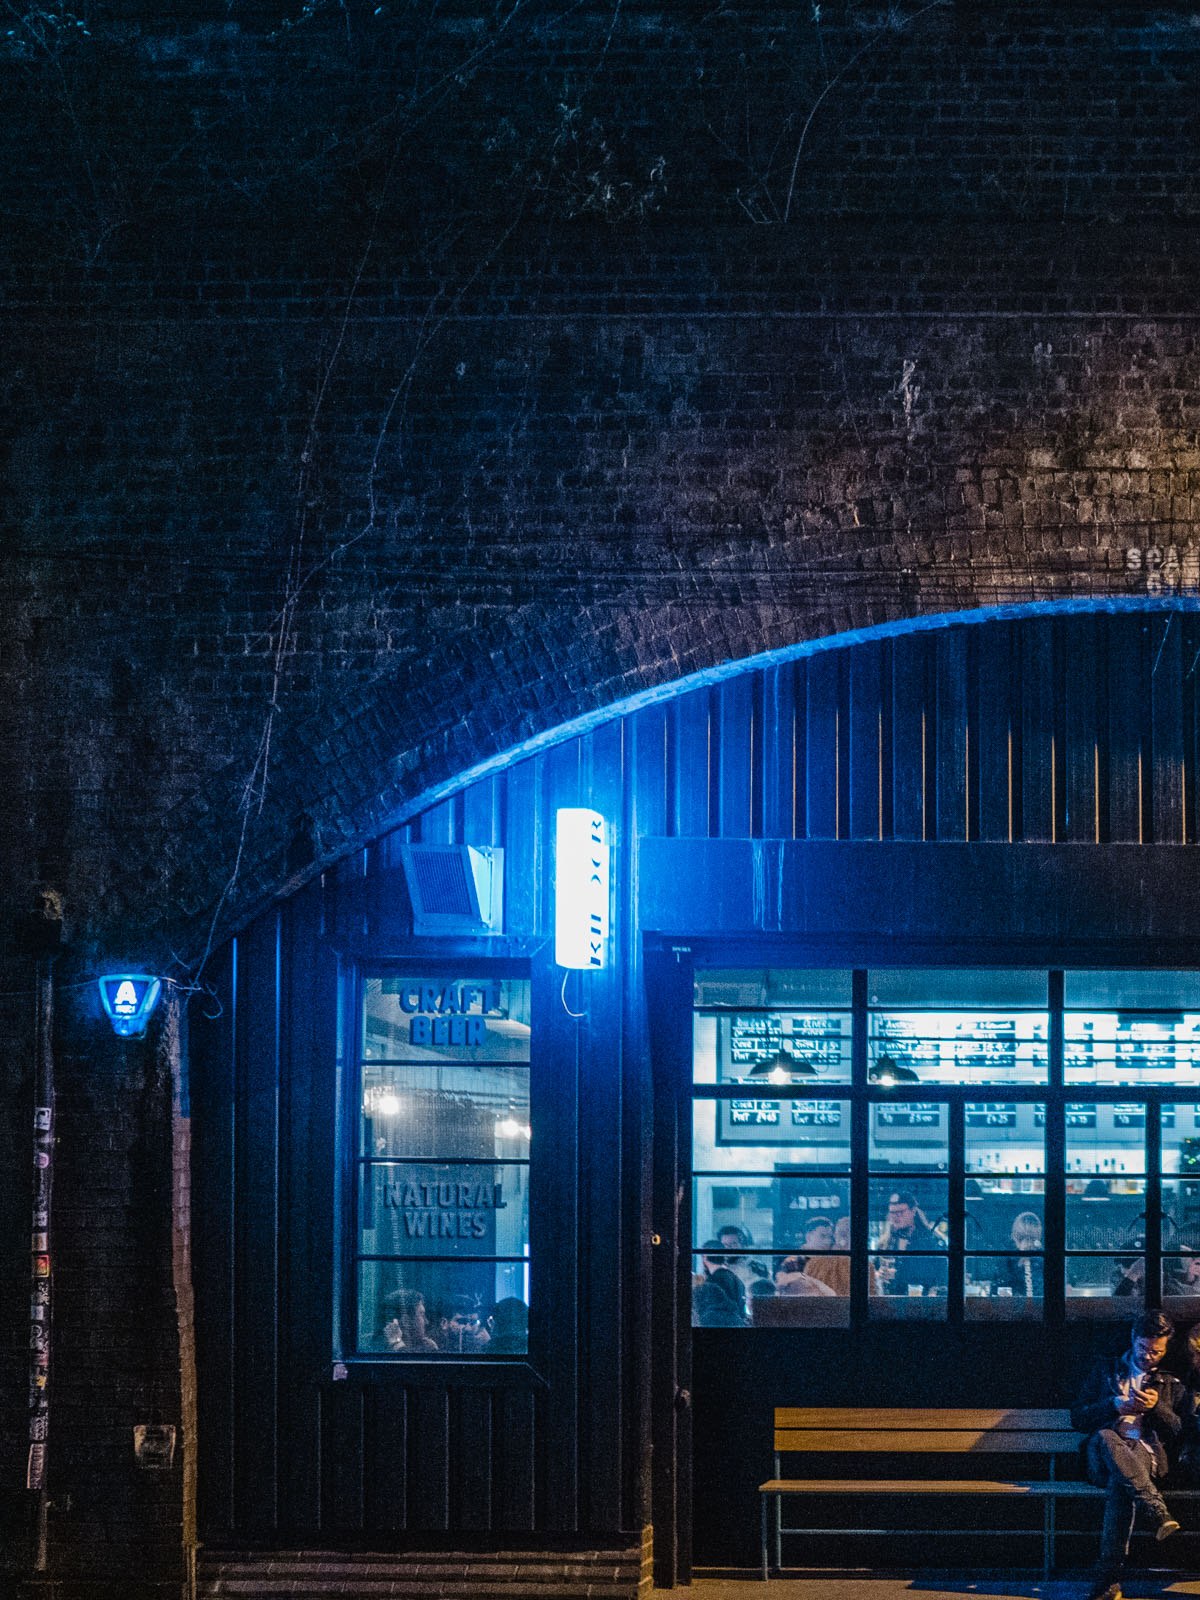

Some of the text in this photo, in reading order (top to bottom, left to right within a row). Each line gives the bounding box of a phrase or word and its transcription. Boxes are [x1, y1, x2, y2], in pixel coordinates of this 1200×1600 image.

[399, 983, 501, 1014] CRAFT
[409, 1015, 487, 1047] BEER
[382, 1181, 508, 1209] NATURAL
[405, 1211, 487, 1239] WINES
